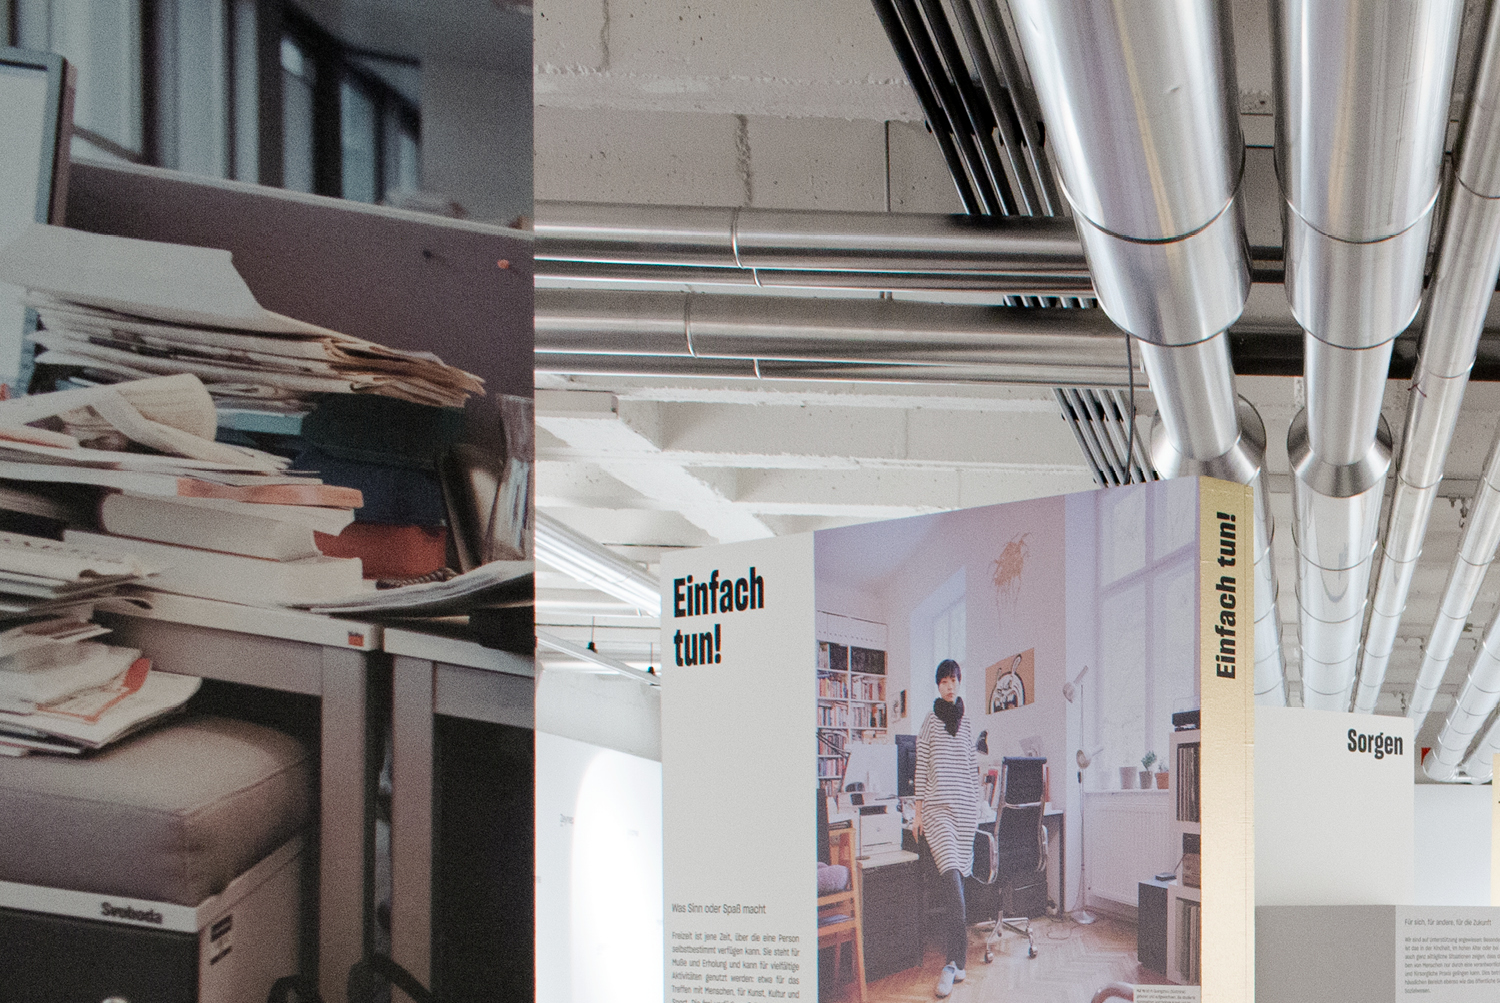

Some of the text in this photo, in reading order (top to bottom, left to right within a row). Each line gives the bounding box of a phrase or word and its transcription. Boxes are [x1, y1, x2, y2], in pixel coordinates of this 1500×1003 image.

[674, 566, 764, 618] Einfach
[1216, 511, 1237, 680] Einfach tun!
[674, 623, 722, 667] tun!
[1348, 729, 1403, 760] Sorgen
[671, 902, 766, 916] Was Sinn oder Spaß macht
